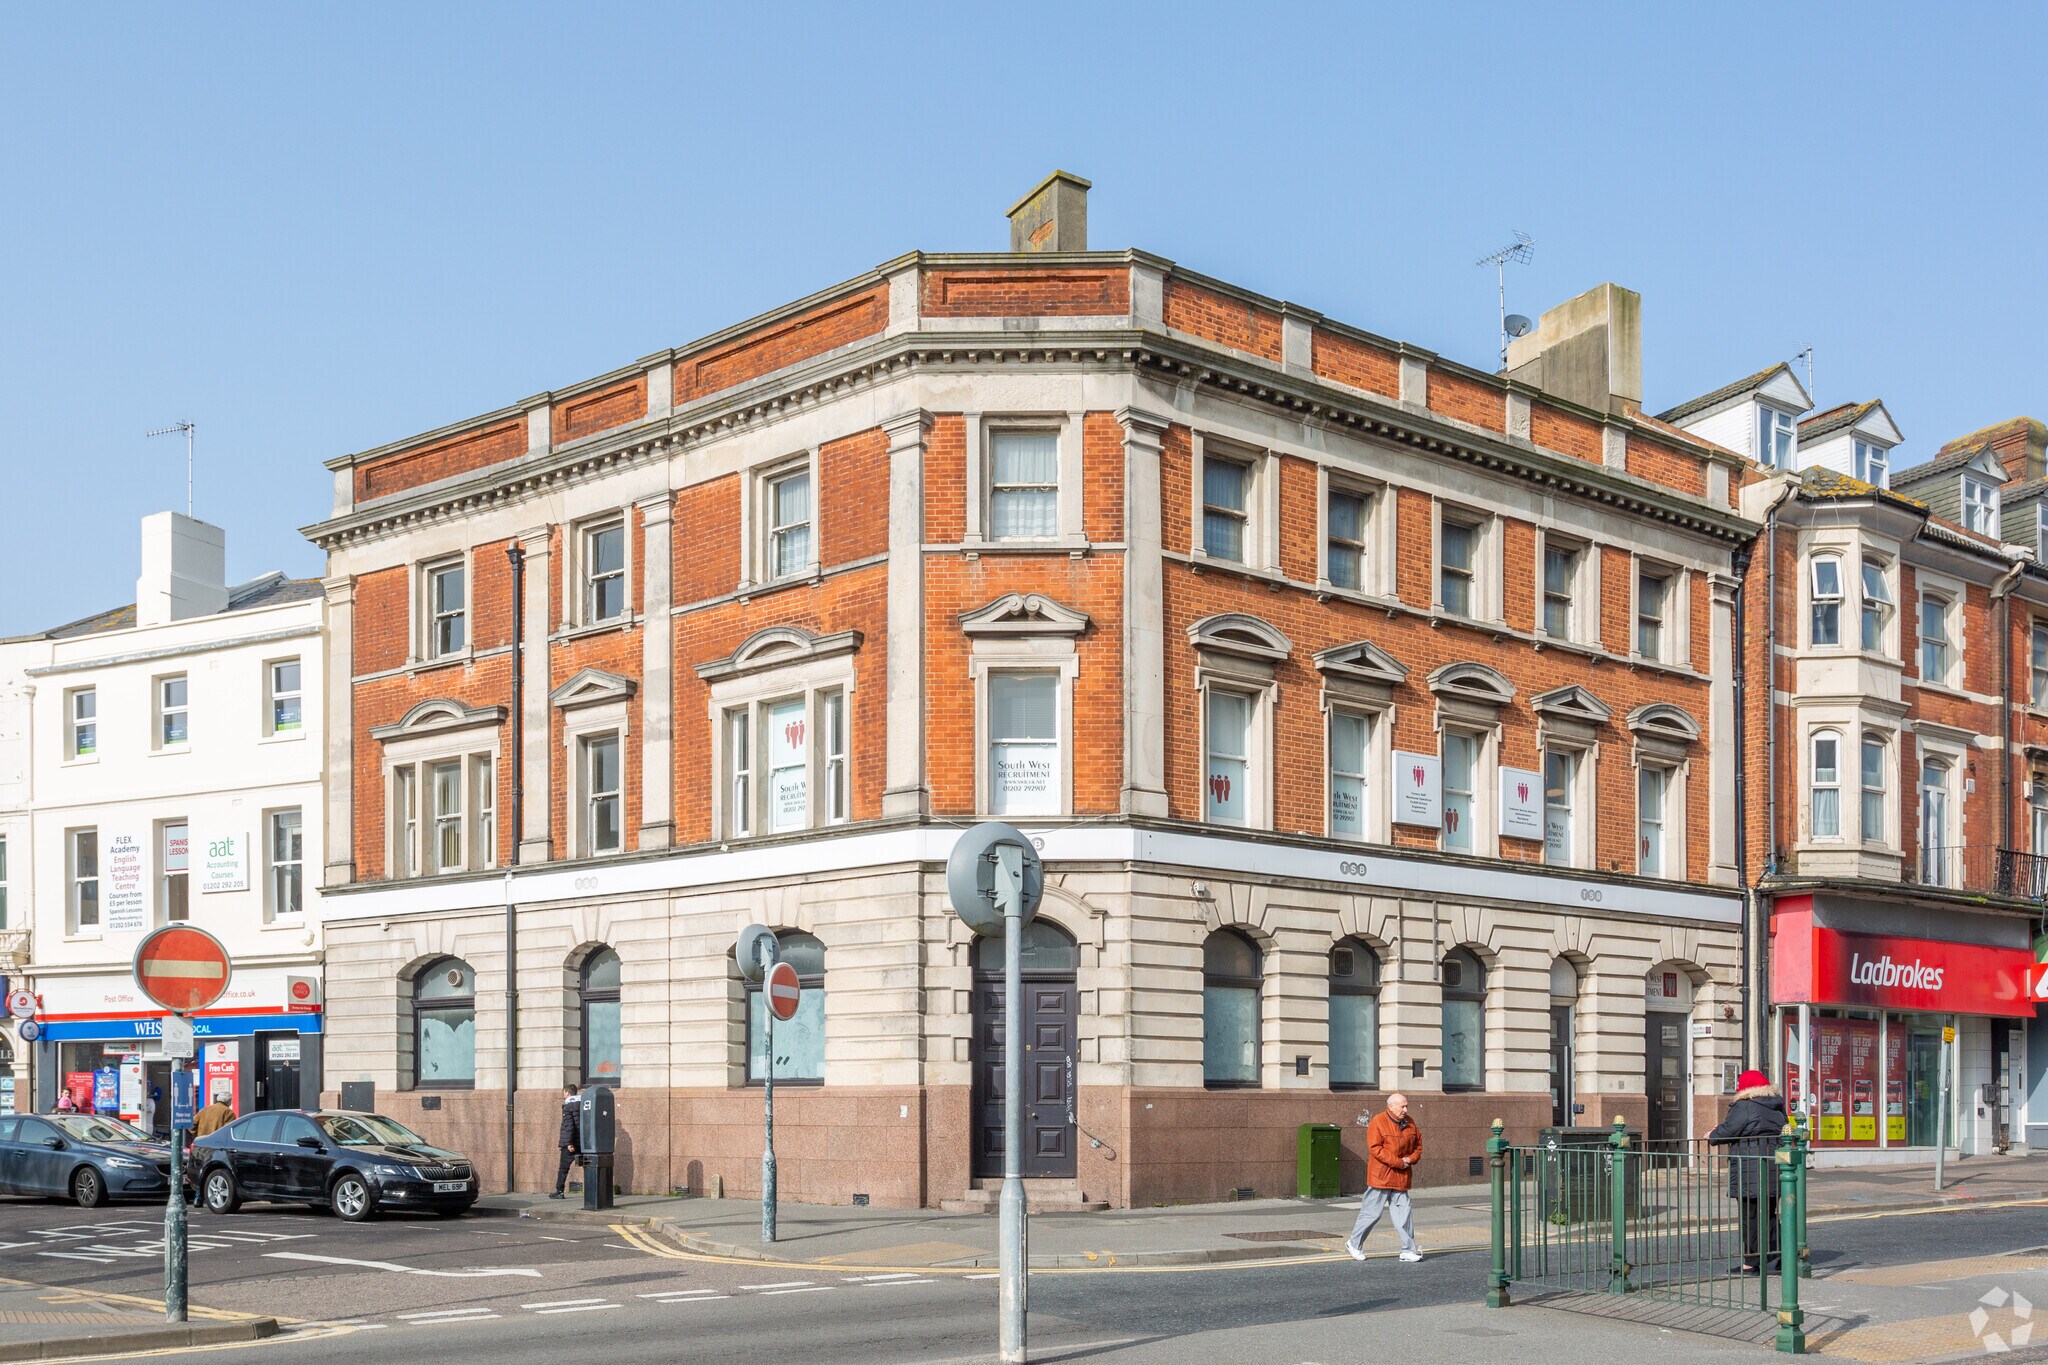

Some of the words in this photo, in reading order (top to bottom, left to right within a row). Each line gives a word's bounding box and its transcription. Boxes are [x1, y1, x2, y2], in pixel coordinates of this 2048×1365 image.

[116, 836, 132, 844] FLEX
[110, 845, 140, 854] Academy
[114, 854, 136, 864] English
[110, 864, 140, 873] Language
[207, 860, 238, 869] Accounting
[1341, 862, 1366, 875] TSB
[112, 873, 139, 882] Teaching
[115, 882, 135, 890] Centre
[1582, 889, 1601, 901] TSB
[1851, 953, 1944, 990] Ladbrokes
[1822, 1036, 1830, 1045] GET
[1832, 1036, 1841, 1045] £20
[1853, 1037, 1861, 1046] GET
[1862, 1038, 1871, 1047] £20
[1828, 1046, 1838, 1055] FREE
[1859, 1047, 1869, 1056] FREE
[1822, 1055, 1833, 1065] BETS
[1853, 1057, 1864, 1066] BETS
[221, 1063, 234, 1072] Cash
